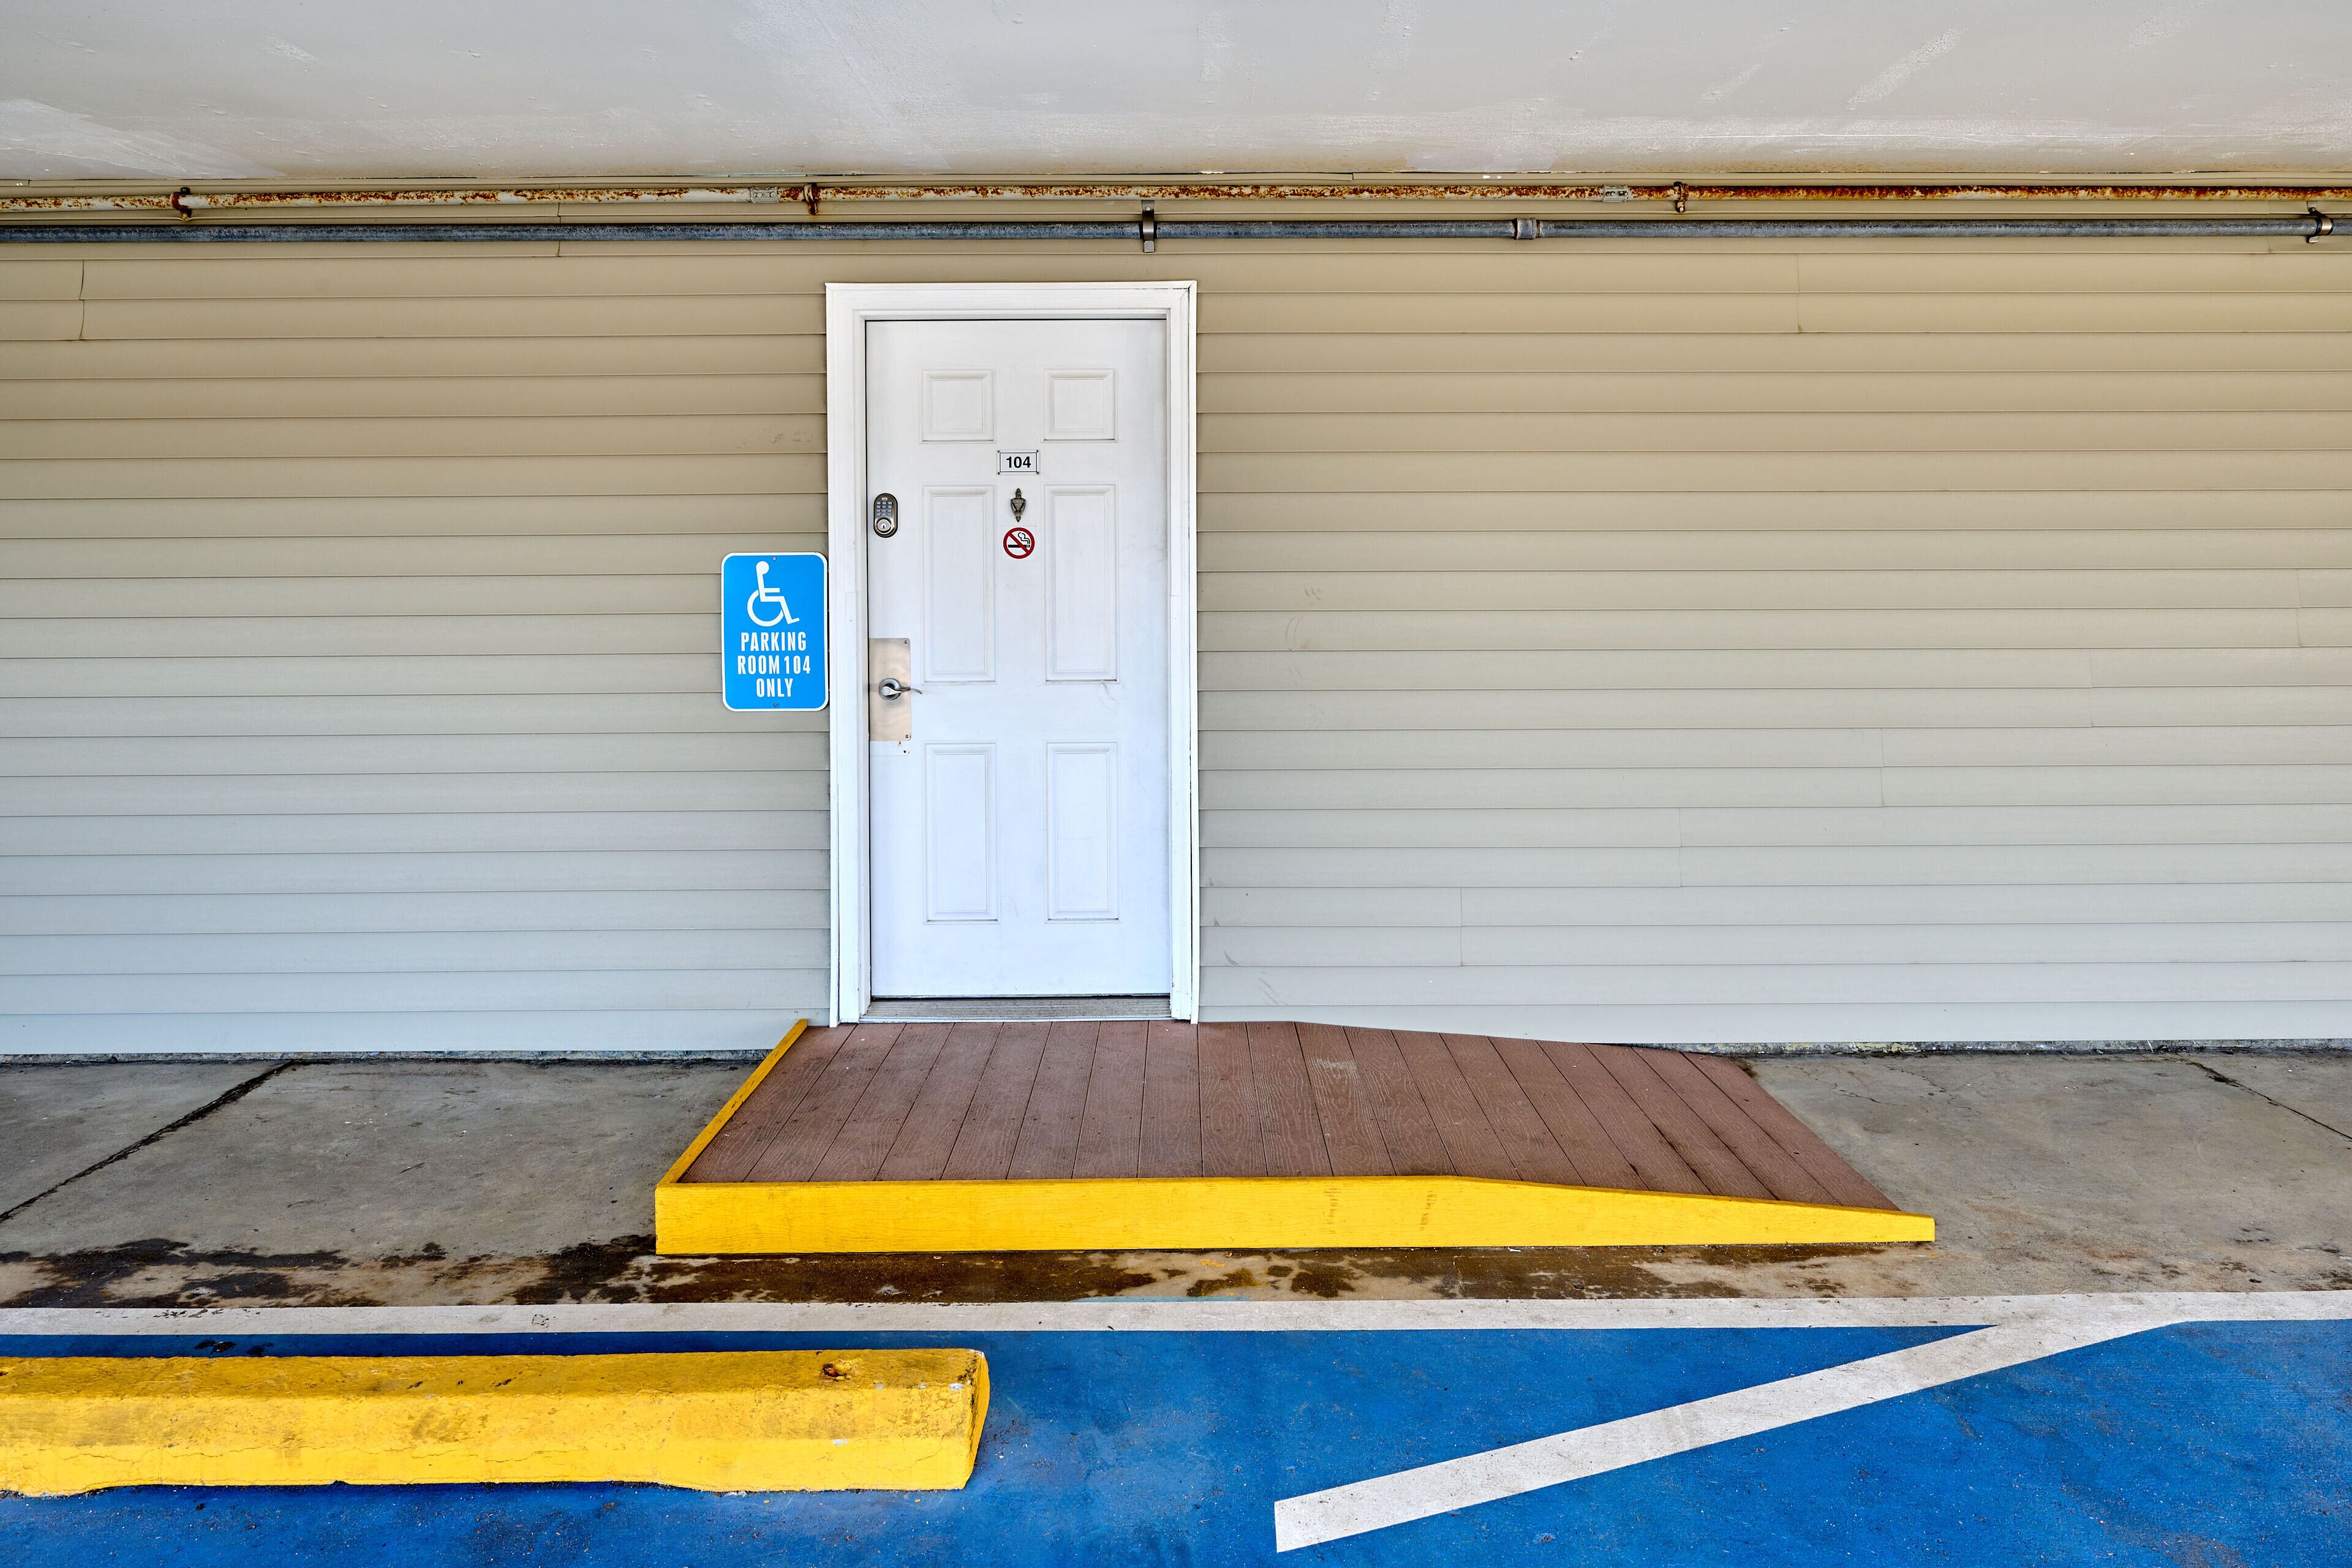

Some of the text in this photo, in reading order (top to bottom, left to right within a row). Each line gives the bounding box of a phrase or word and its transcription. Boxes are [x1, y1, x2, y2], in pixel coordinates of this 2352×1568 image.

[1006, 456, 1031, 469] 104
[741, 631, 807, 652] PARKING
[737, 655, 811, 674] ROOM 104
[756, 678, 793, 698] ONLY
